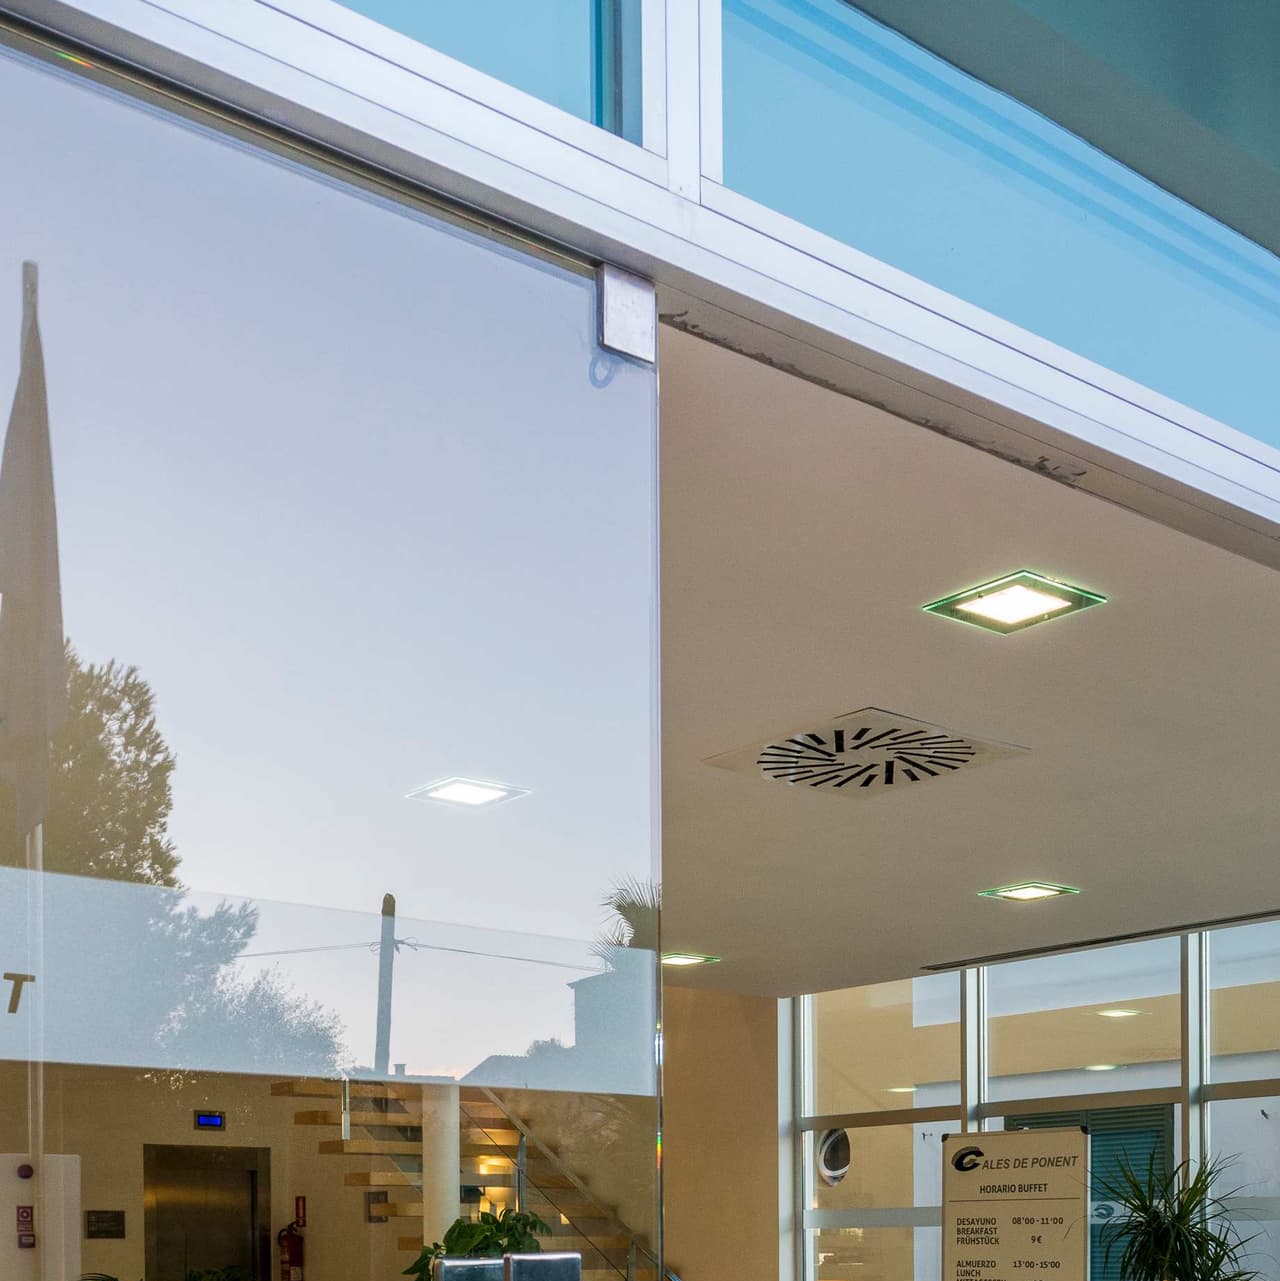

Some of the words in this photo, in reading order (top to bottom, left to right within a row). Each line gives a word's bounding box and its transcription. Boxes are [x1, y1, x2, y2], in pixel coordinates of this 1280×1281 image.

[1013, 1158, 1028, 1169] DE
[1031, 1156, 1078, 1169] PONENT
[980, 1184, 1016, 1194] HORARIO
[1018, 1183, 1048, 1193] BUFFET
[957, 1217, 996, 1226] DESAYUNO
[957, 1227, 997, 1235] BREAKFAST
[957, 1235, 999, 1245] FRÜHSTÜCK
[956, 1260, 996, 1268] ALMUERZO
[956, 1269, 981, 1277] LUNCH
